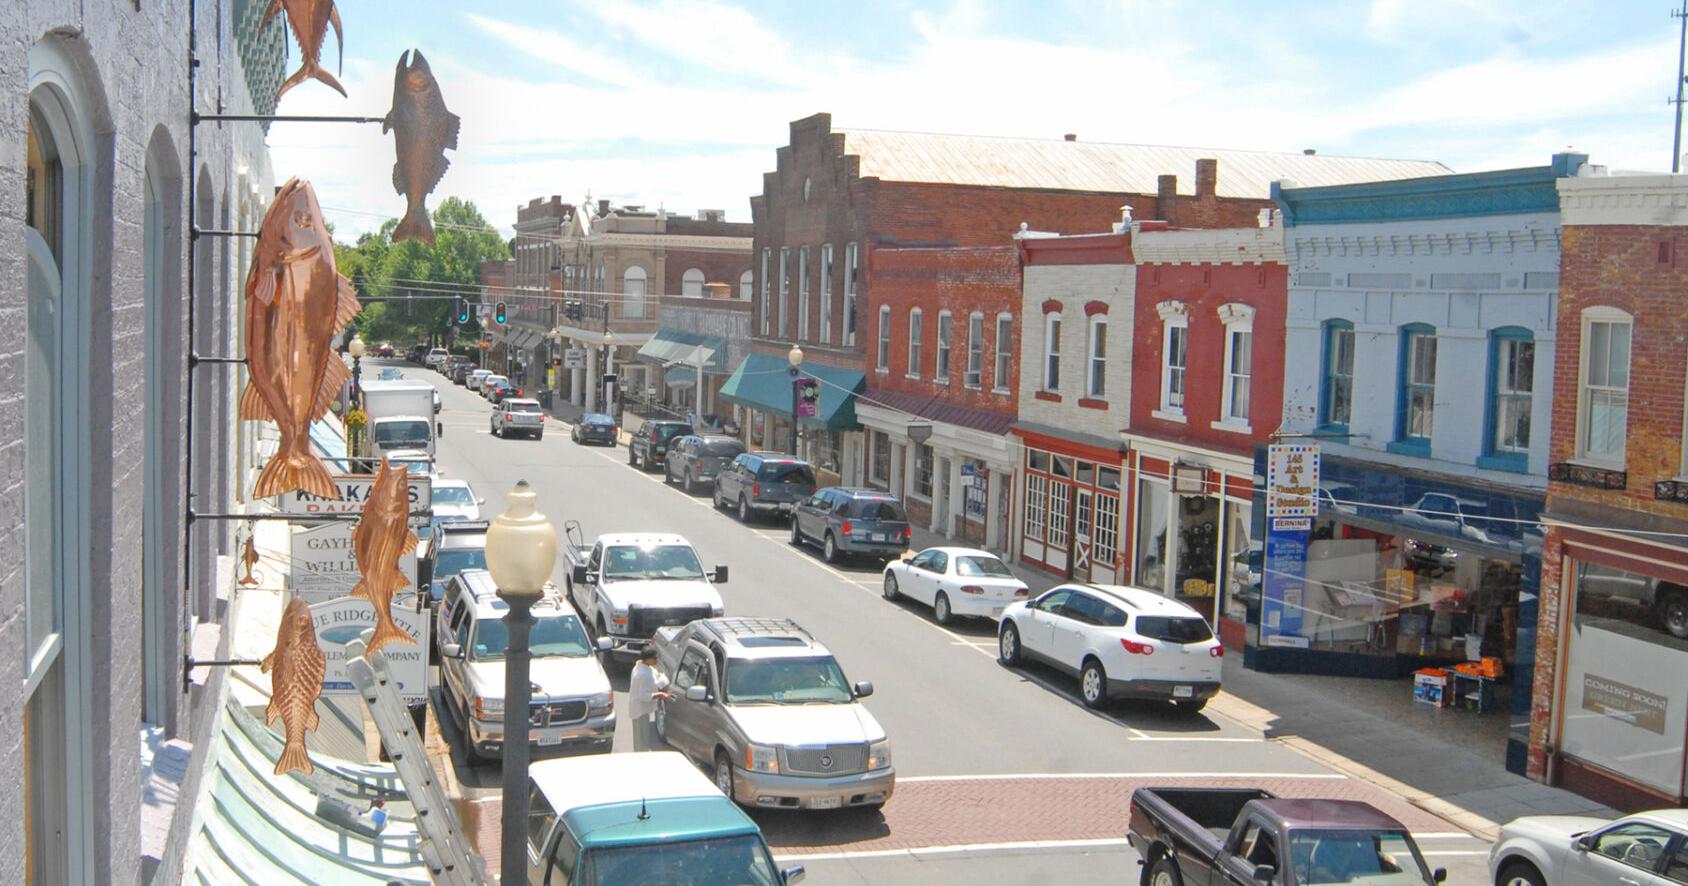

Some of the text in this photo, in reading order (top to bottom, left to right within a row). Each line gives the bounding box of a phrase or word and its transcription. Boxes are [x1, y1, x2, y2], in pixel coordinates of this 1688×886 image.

[1285, 464, 1304, 474] Art
[1276, 485, 1312, 495] Design
[1276, 497, 1311, 508] Studio
